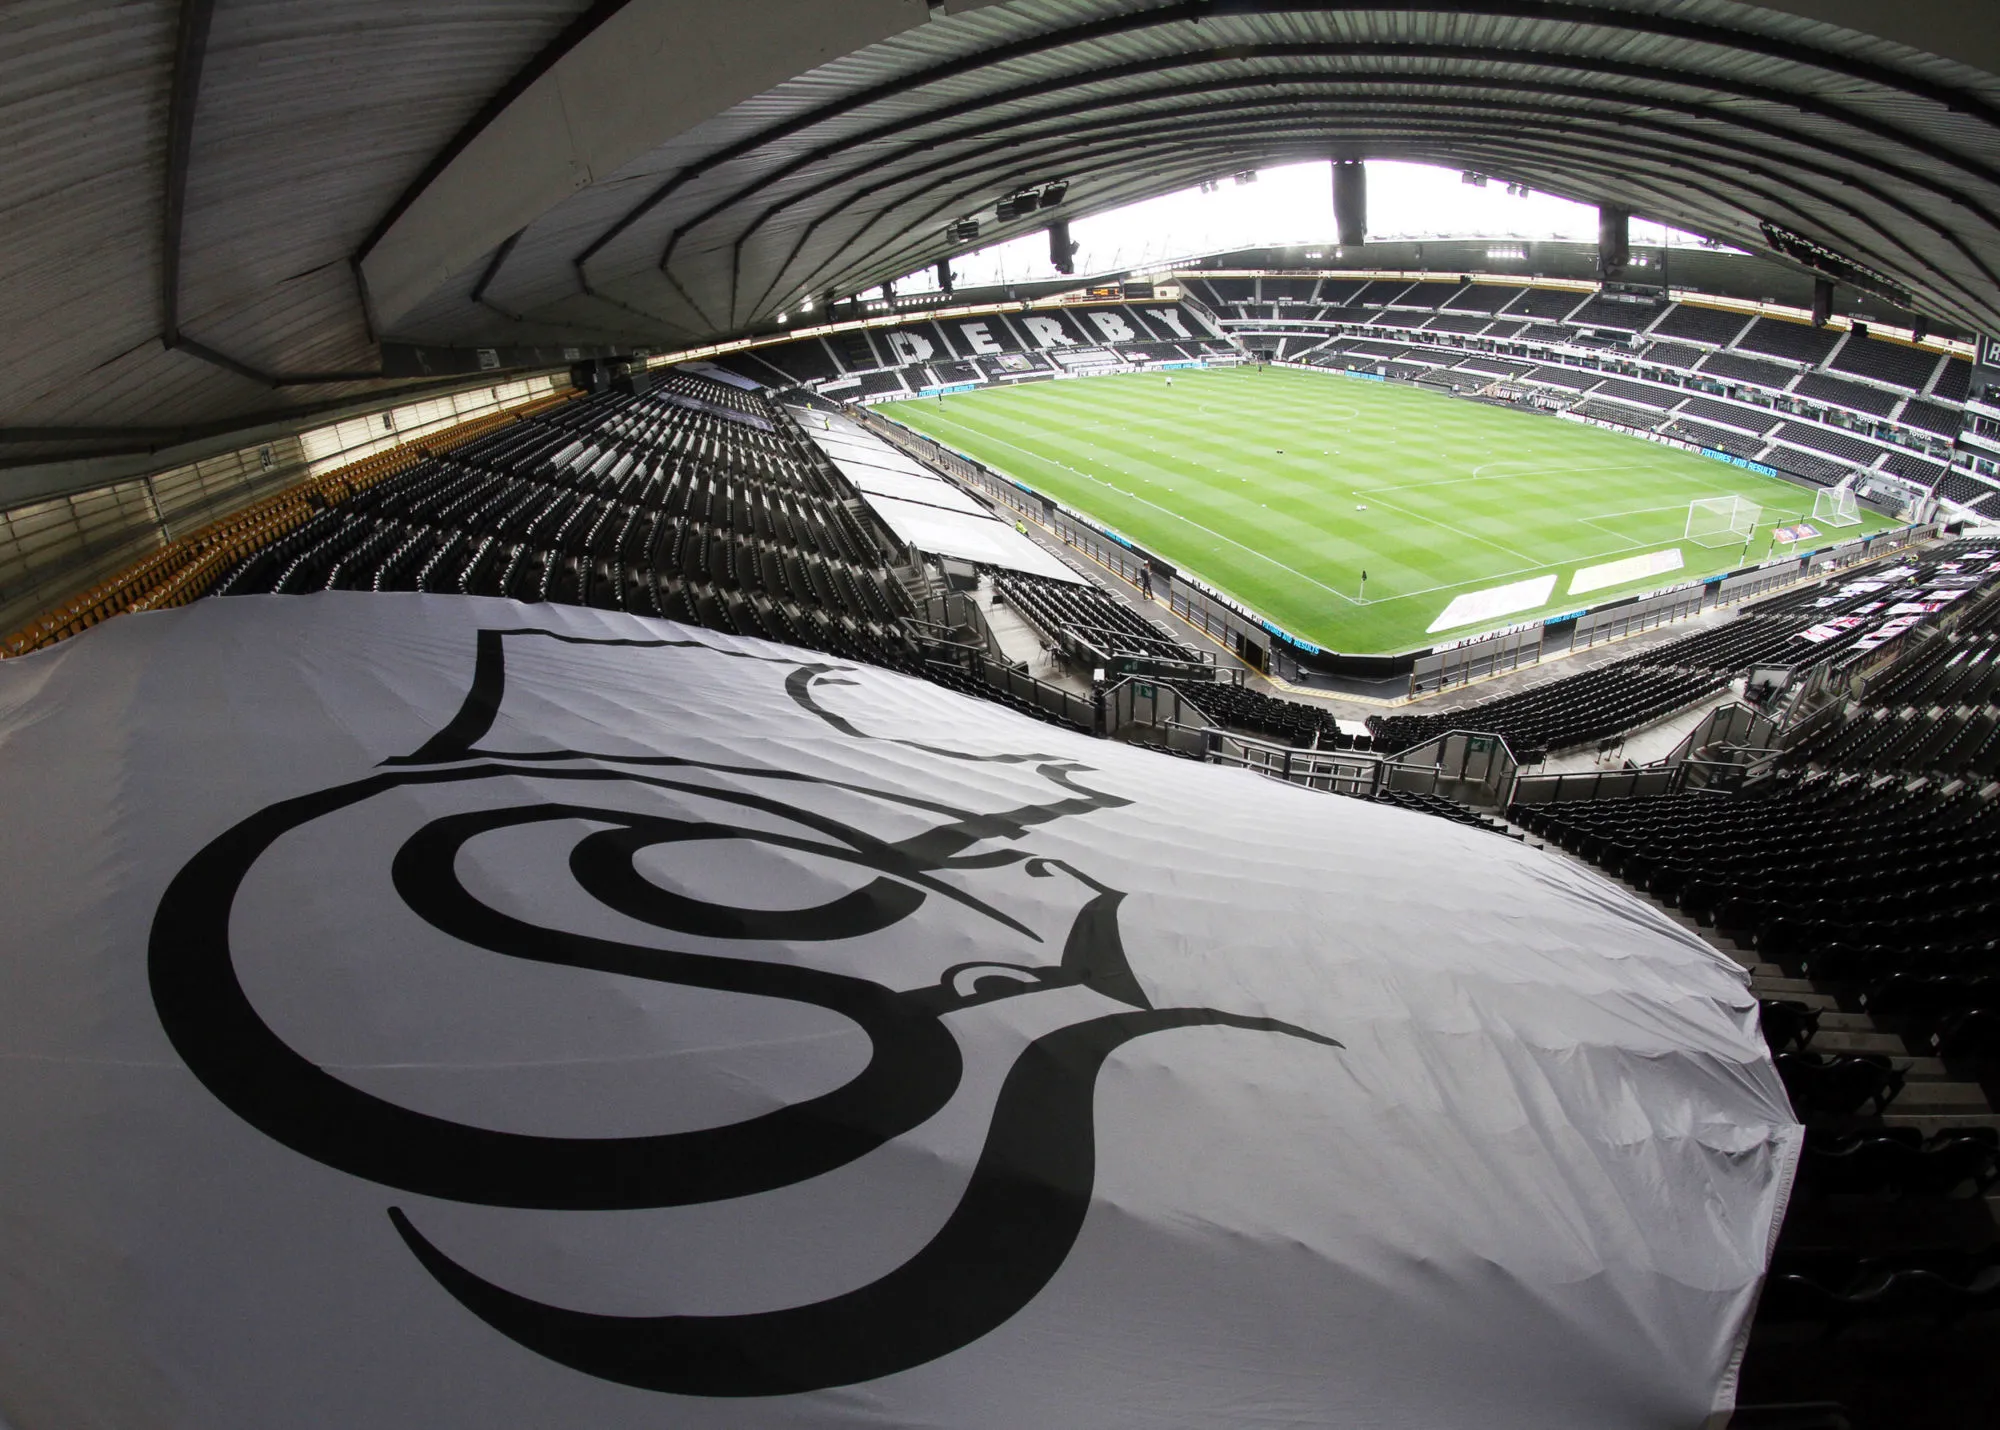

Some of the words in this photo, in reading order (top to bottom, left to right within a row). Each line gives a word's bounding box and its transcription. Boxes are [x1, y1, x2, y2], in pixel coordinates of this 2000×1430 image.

[885, 308, 1192, 364] DERBY
[1760, 389, 1781, 399] TOYOTA
[1807, 401, 1829, 412] TOYOTA
[1856, 414, 1880, 426] TOYOTA
[1908, 429, 1933, 442] TOYOTA
[1701, 447, 1732, 464] FIXTURES
[1732, 457, 1748, 469] AND
[1748, 461, 1778, 478] RESULTS
[1282, 632, 1293, 644] AND
[1293, 639, 1320, 655] RESULTS
